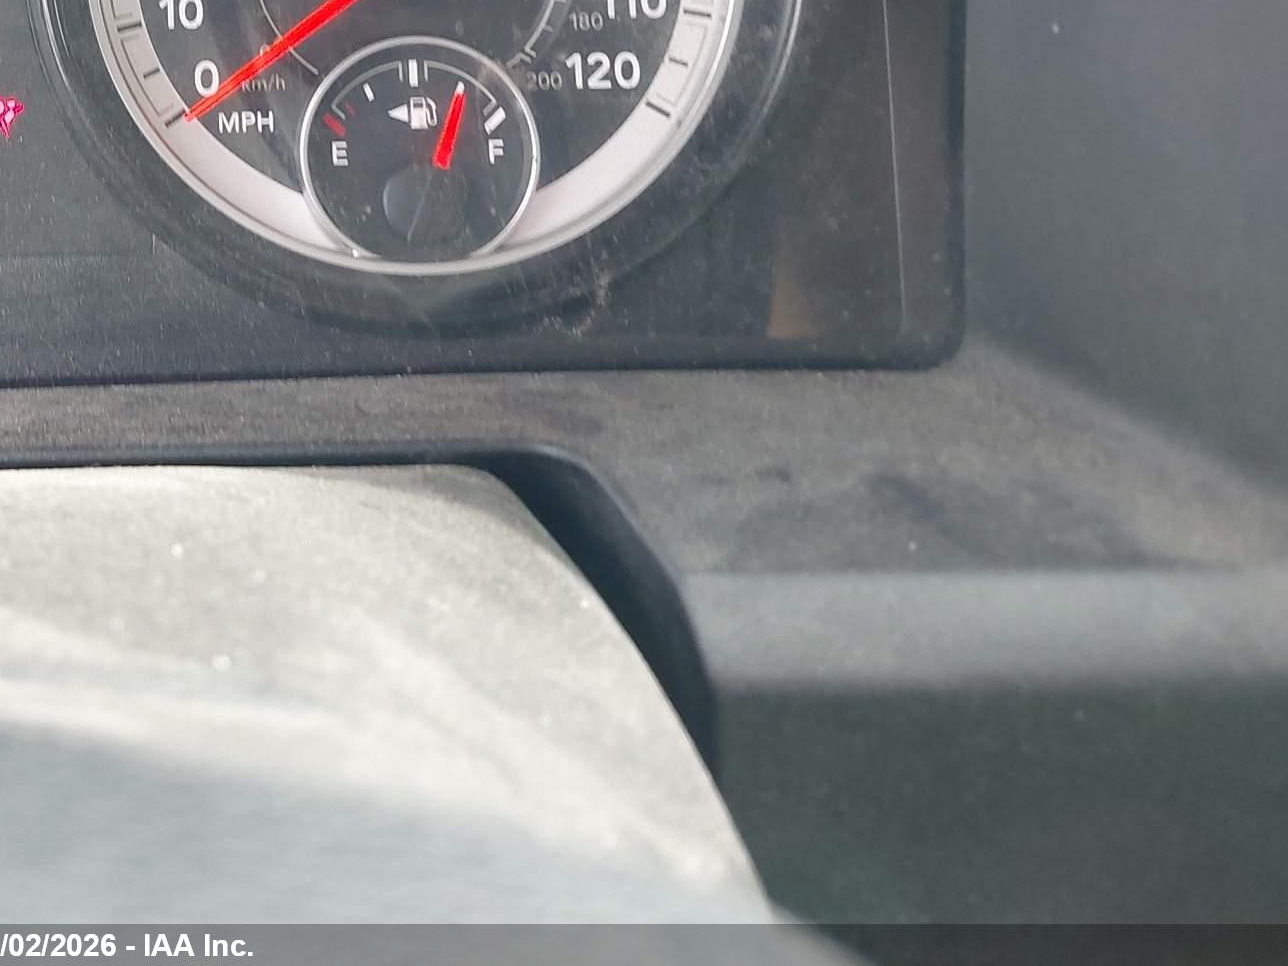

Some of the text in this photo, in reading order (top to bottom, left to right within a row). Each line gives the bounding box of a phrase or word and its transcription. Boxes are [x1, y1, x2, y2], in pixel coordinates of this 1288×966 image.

[568, 11, 604, 32] 180
[194, 59, 220, 98] 0
[526, 71, 562, 90] 200
[565, 50, 641, 91] 120
[218, 110, 275, 134] MPH
[330, 139, 349, 167] E
[488, 138, 505, 165] F
